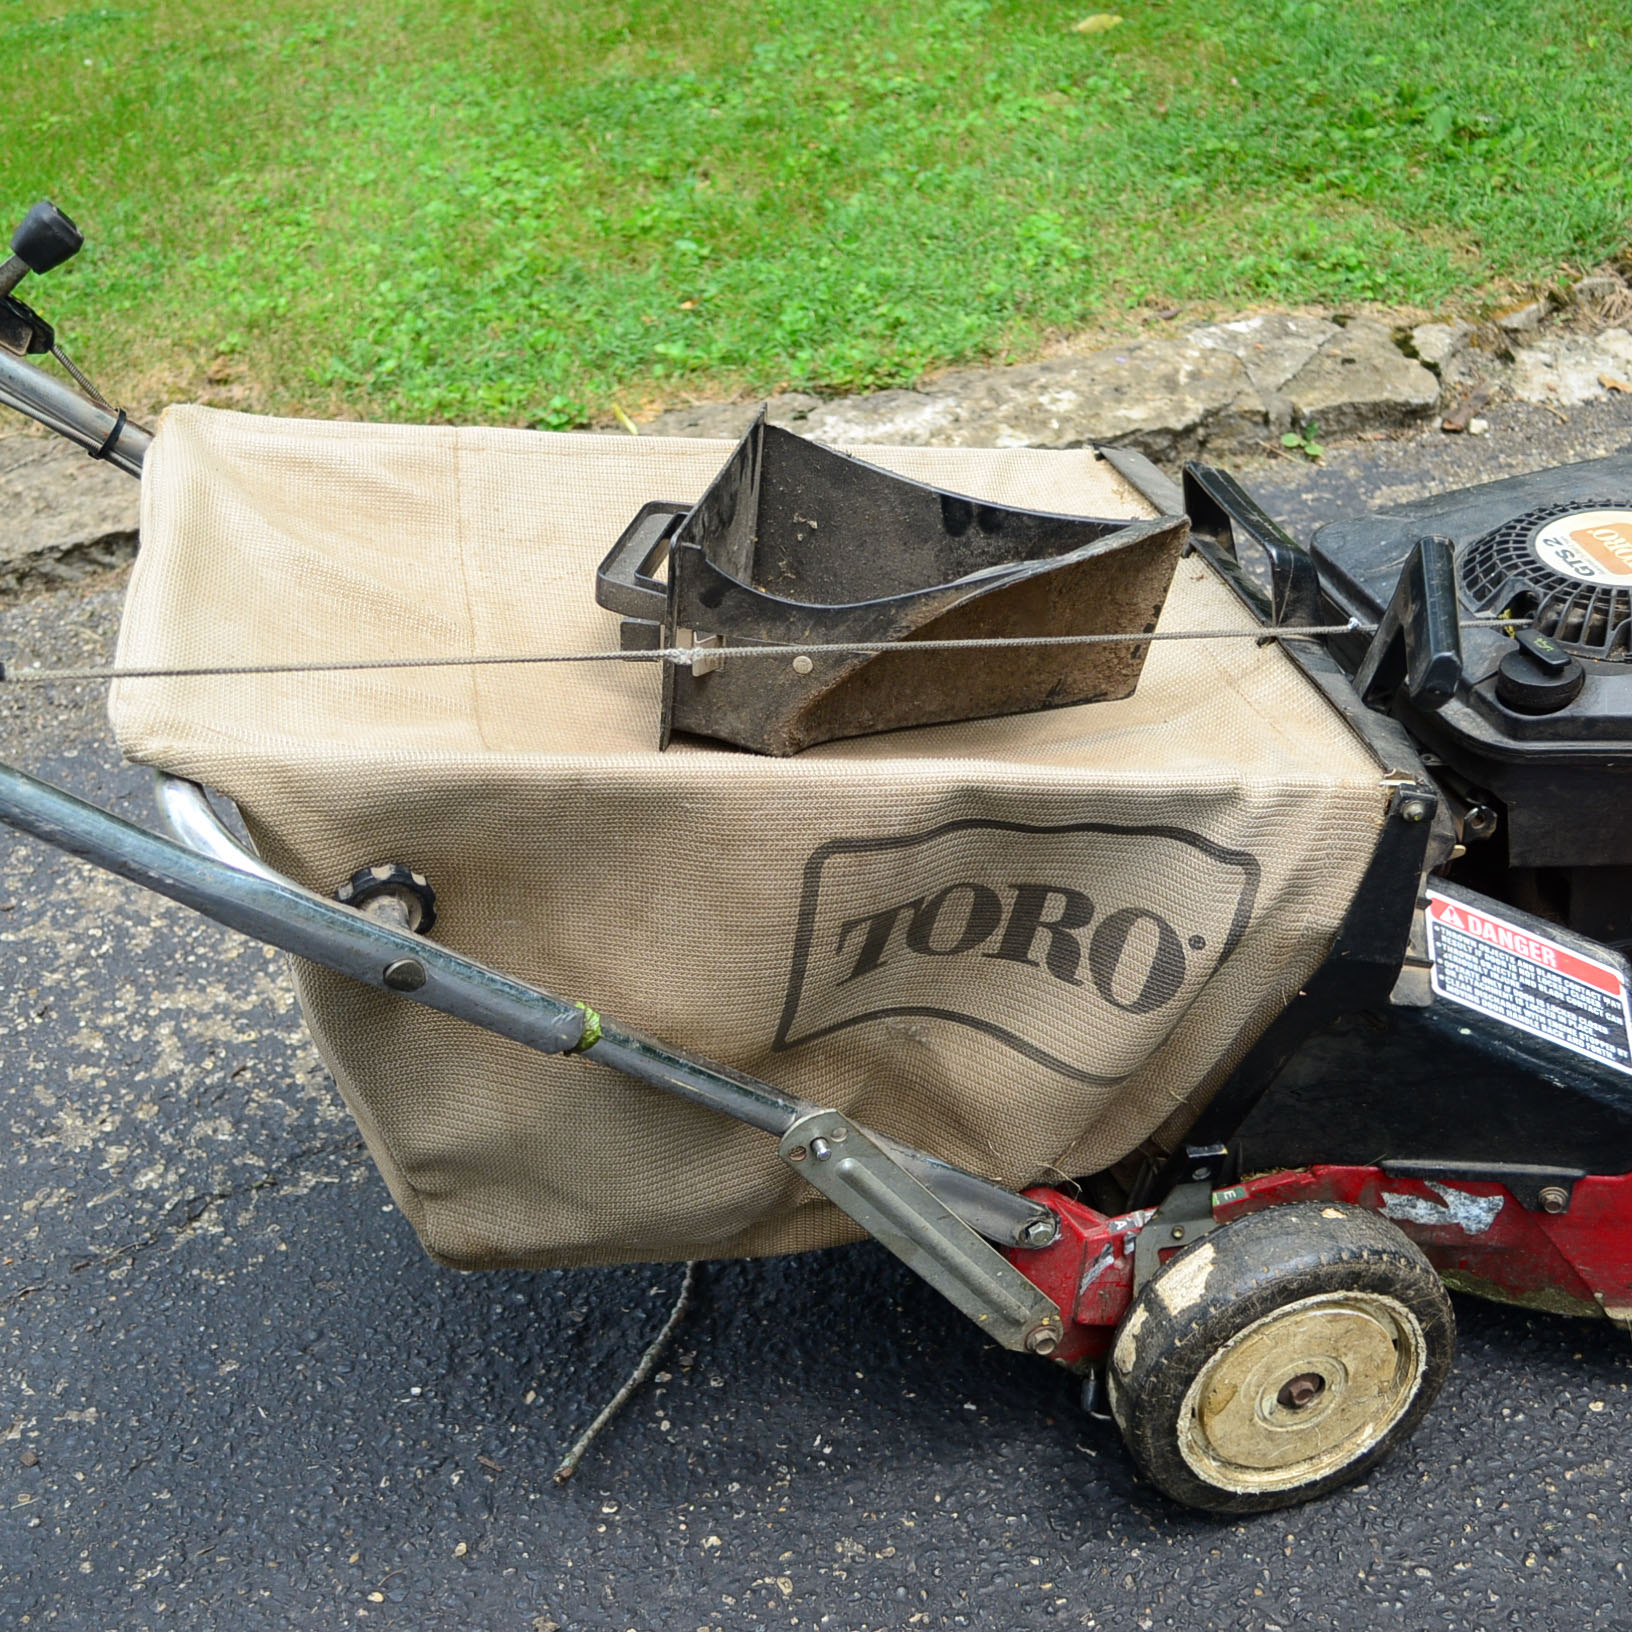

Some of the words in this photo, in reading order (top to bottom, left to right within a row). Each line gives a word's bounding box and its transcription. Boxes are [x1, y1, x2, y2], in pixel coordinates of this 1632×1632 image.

[1543, 537, 1564, 547] 2
[1555, 549, 1595, 577] GTS
[836, 882, 1187, 1014] TORO
[1441, 926, 1477, 948] THROWN
[1478, 942, 1515, 964] OBJECTS
[1467, 913, 1557, 969] DANGER
[1442, 942, 1478, 964] THROWN
[1480, 958, 1517, 981] OBJECTS
[1114, 1219, 1128, 1230] A
